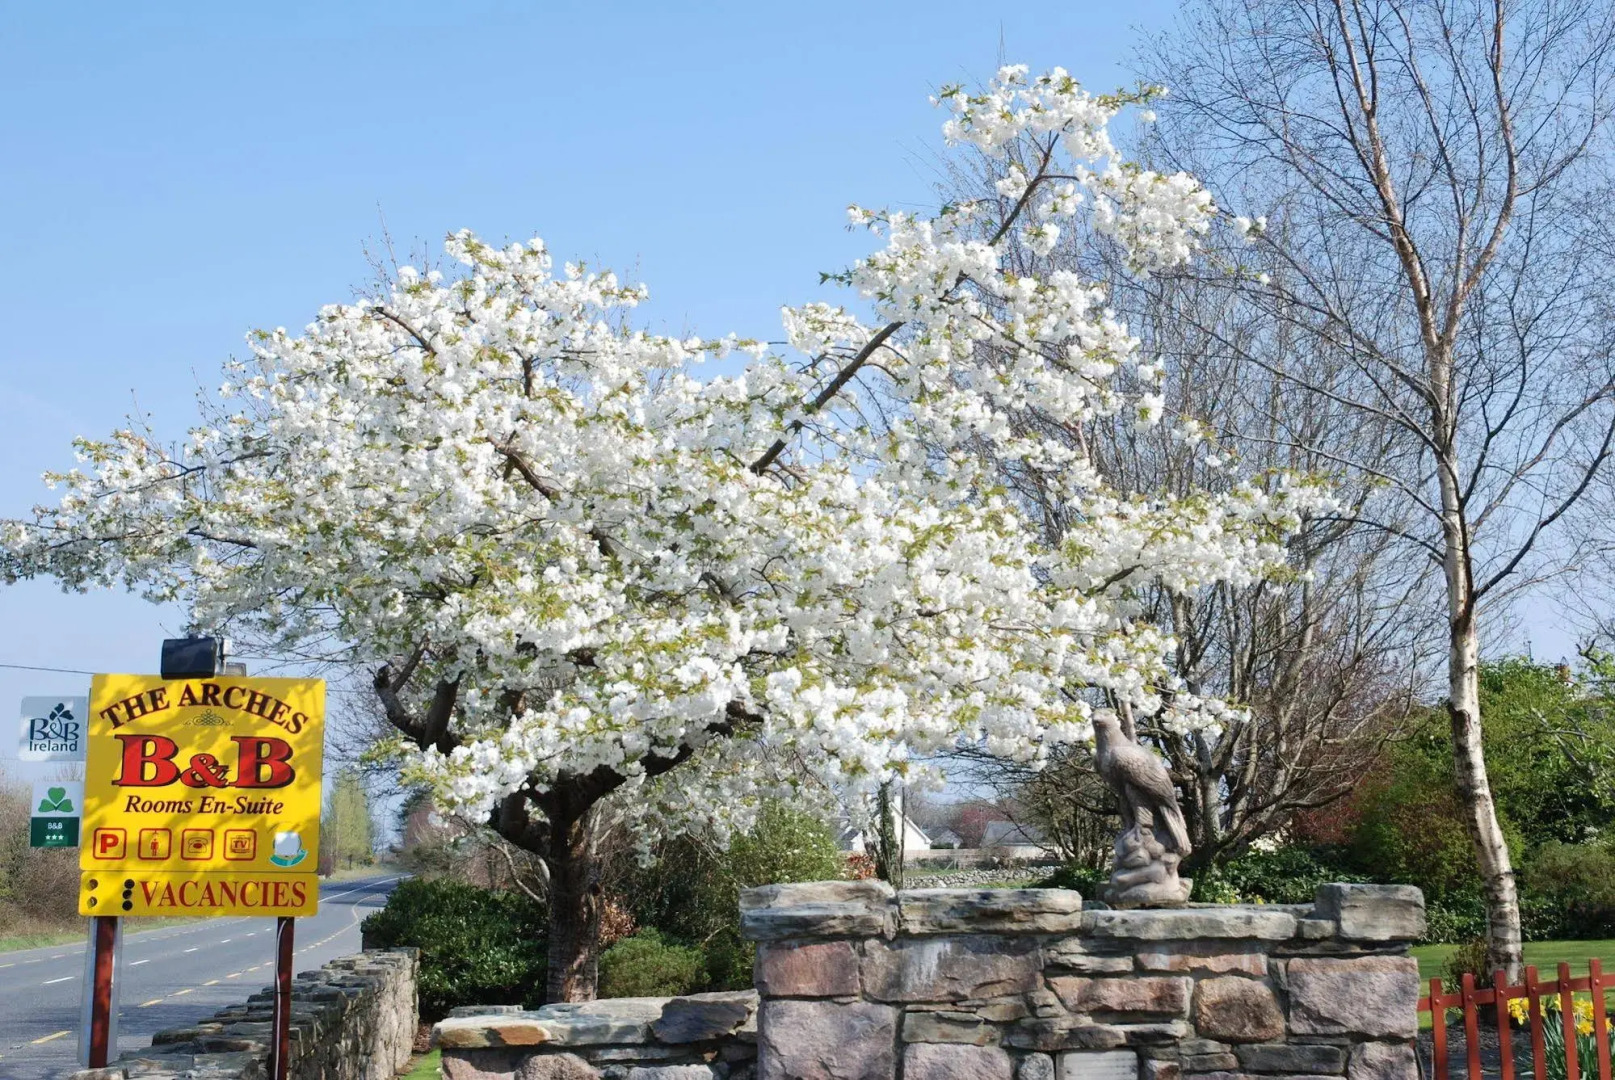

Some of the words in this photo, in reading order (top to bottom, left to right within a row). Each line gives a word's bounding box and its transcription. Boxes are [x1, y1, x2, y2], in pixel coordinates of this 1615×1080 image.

[100, 687, 170, 730] THE
[178, 683, 309, 735] ARCHES
[30, 718, 79, 741] B&B
[29, 740, 77, 752] Ireland
[112, 734, 296, 788] B&B
[125, 795, 193, 814] Rooms
[198, 796, 284, 815] En-Suite
[47, 822, 63, 830] B&B
[100, 834, 119, 853] P
[233, 840, 248, 849] TV
[140, 880, 307, 908] VACANCIES
